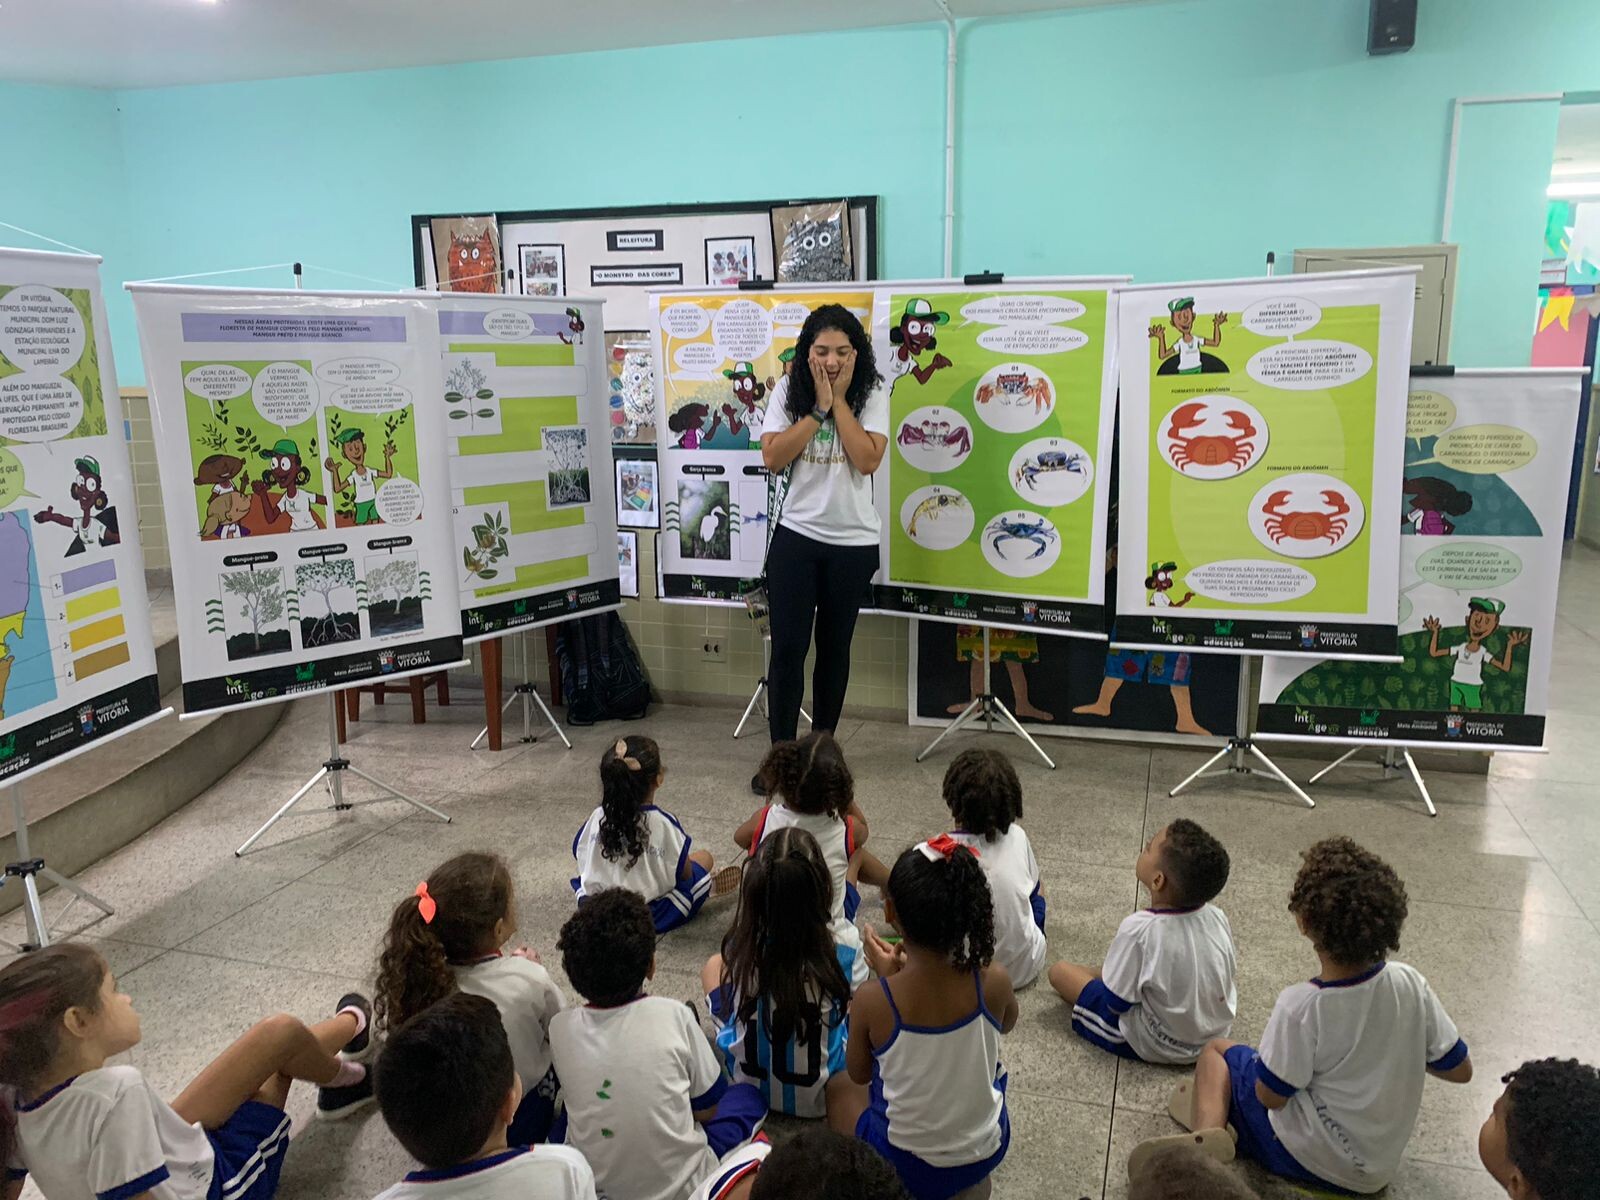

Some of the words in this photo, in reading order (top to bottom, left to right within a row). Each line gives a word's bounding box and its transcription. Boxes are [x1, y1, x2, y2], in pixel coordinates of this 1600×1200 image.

[2, 384, 19, 392] ALÉM
[21, 394, 34, 402] QUE
[40, 393, 52, 401] UMA
[65, 391, 73, 399] DE
[2, 415, 36, 424] PROTEGIDA
[8, 426, 40, 434] FLORESTAL
[5, 464, 18, 474] QUE
[579, 595, 600, 604] VITÓRIA
[1039, 614, 1071, 623] VITÓRIA
[1203, 638, 1244, 648] educação
[1320, 637, 1358, 646] VITÓRIA
[397, 656, 431, 671] VITÓRIA
[97, 705, 130, 724] VITÓRIA
[1347, 729, 1389, 738] educação
[1466, 727, 1504, 736] VITÓRIA
